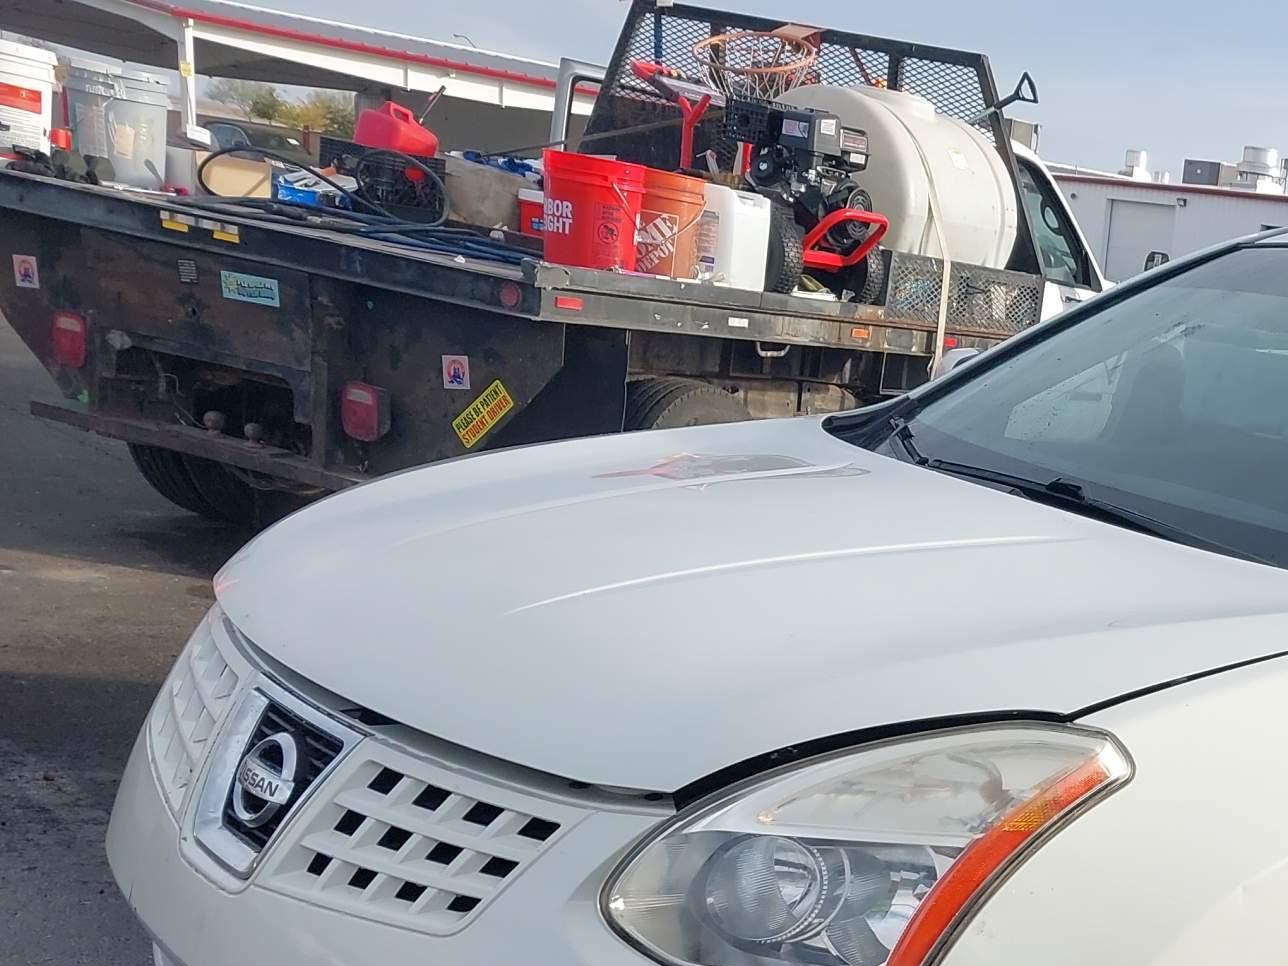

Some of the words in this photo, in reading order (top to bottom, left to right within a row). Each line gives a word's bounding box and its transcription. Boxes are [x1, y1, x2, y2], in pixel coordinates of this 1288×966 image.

[455, 410, 477, 433] PLEASE
[471, 403, 484, 418] BE
[479, 384, 503, 411] PATIENT
[462, 414, 489, 444] STUDENT
[486, 394, 510, 421] DRIVER
